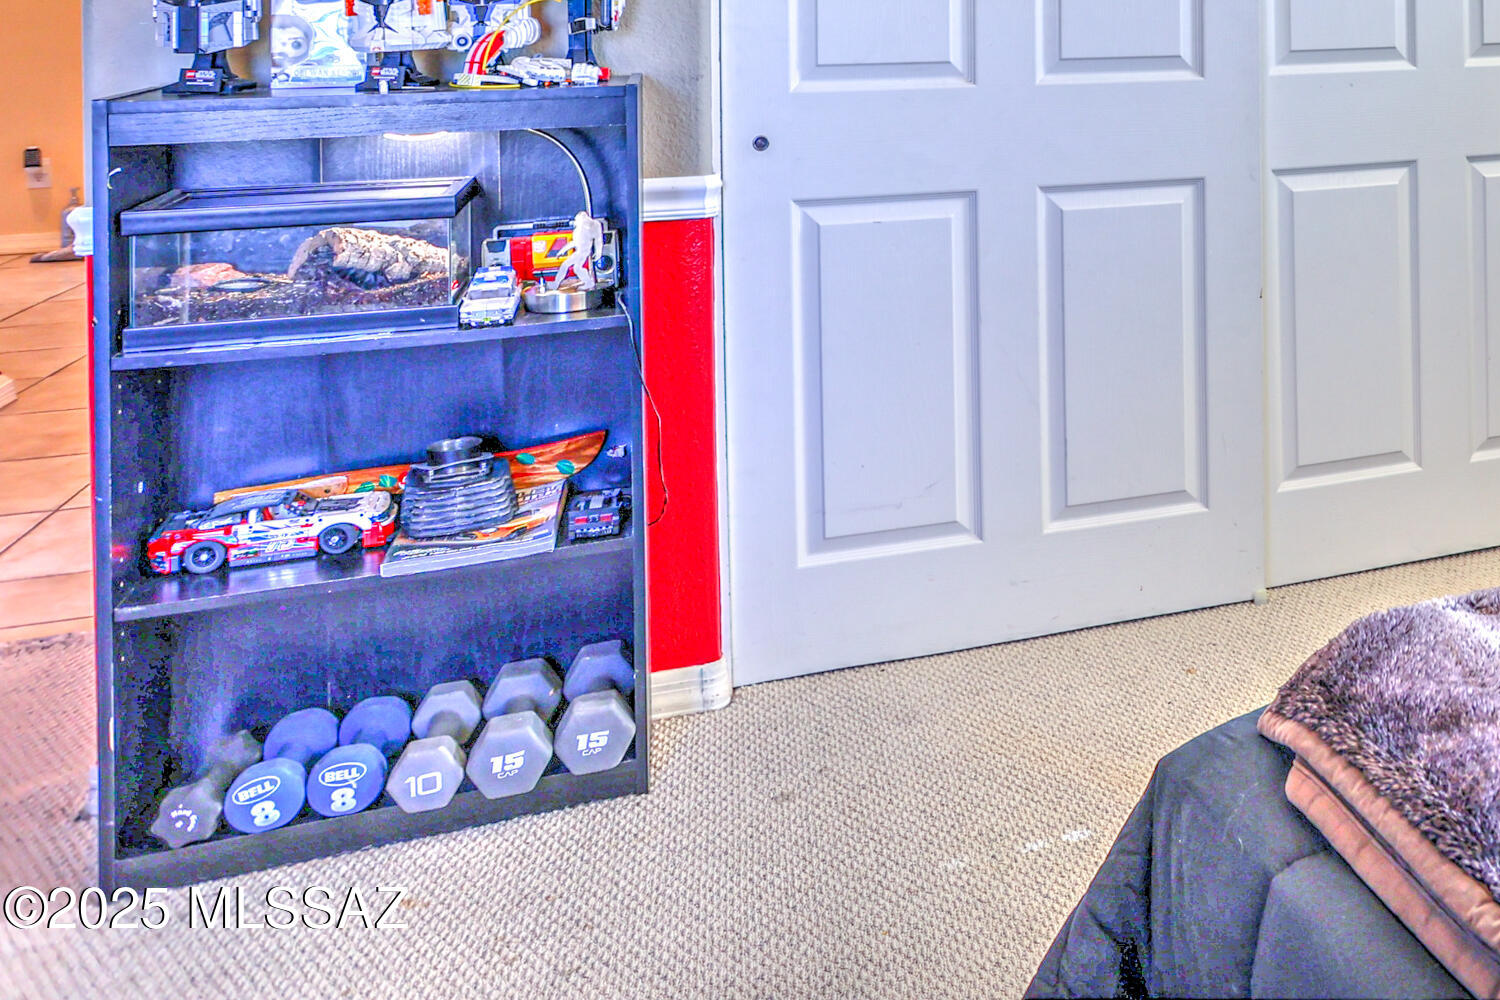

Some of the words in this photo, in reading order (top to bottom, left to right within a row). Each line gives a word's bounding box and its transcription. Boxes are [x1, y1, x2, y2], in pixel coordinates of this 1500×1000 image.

[576, 730, 610, 752] 15
[582, 746, 603, 757] CAP
[490, 750, 525, 774] 15
[324, 766, 361, 783] BELL
[404, 771, 443, 797] 10
[497, 769, 519, 779] CAP
[238, 780, 275, 802] BELL
[330, 787, 357, 812] 8
[250, 800, 281, 827] 8
